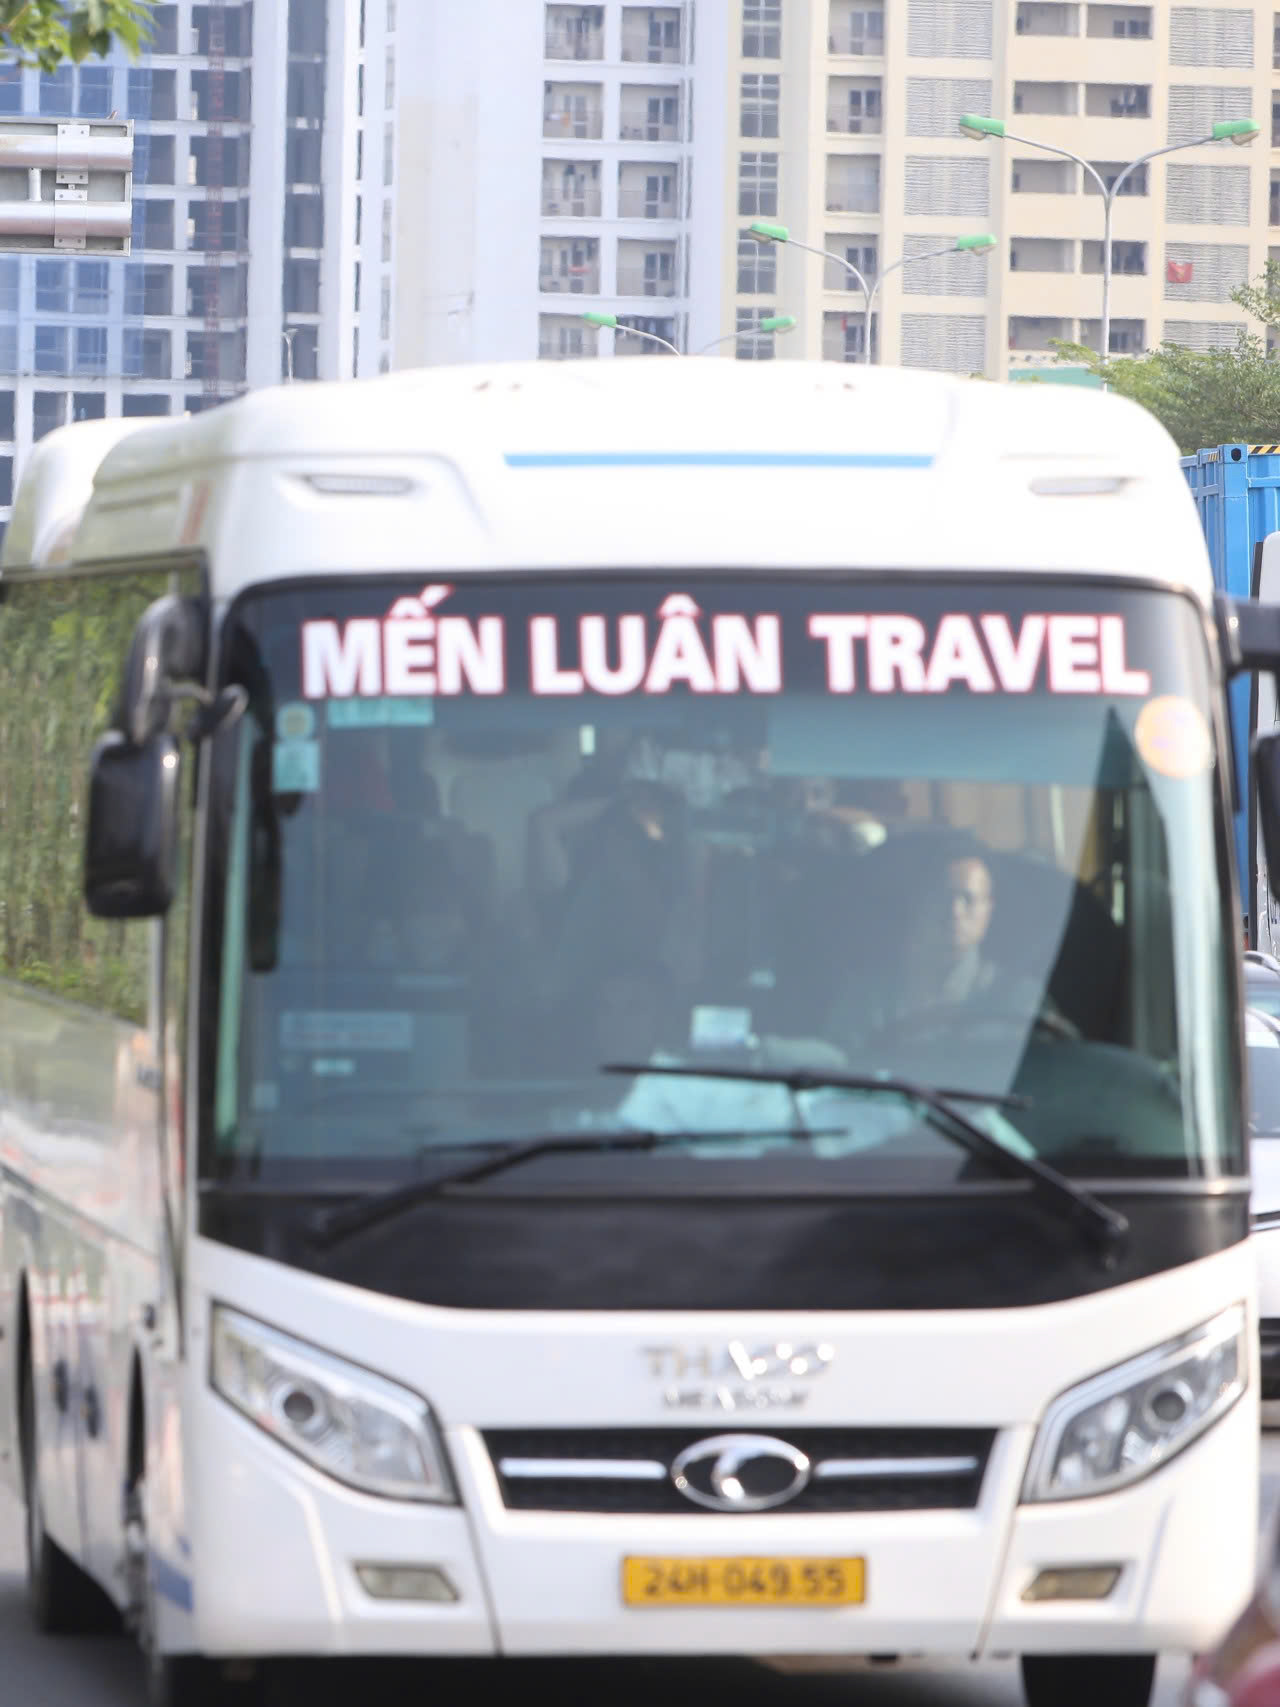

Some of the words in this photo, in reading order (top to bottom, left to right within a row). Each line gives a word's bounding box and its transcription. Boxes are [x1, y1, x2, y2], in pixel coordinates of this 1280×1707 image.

[302, 584, 504, 698] MẾN
[528, 592, 783, 696] LUÂN
[807, 612, 1152, 696] TRAVEL
